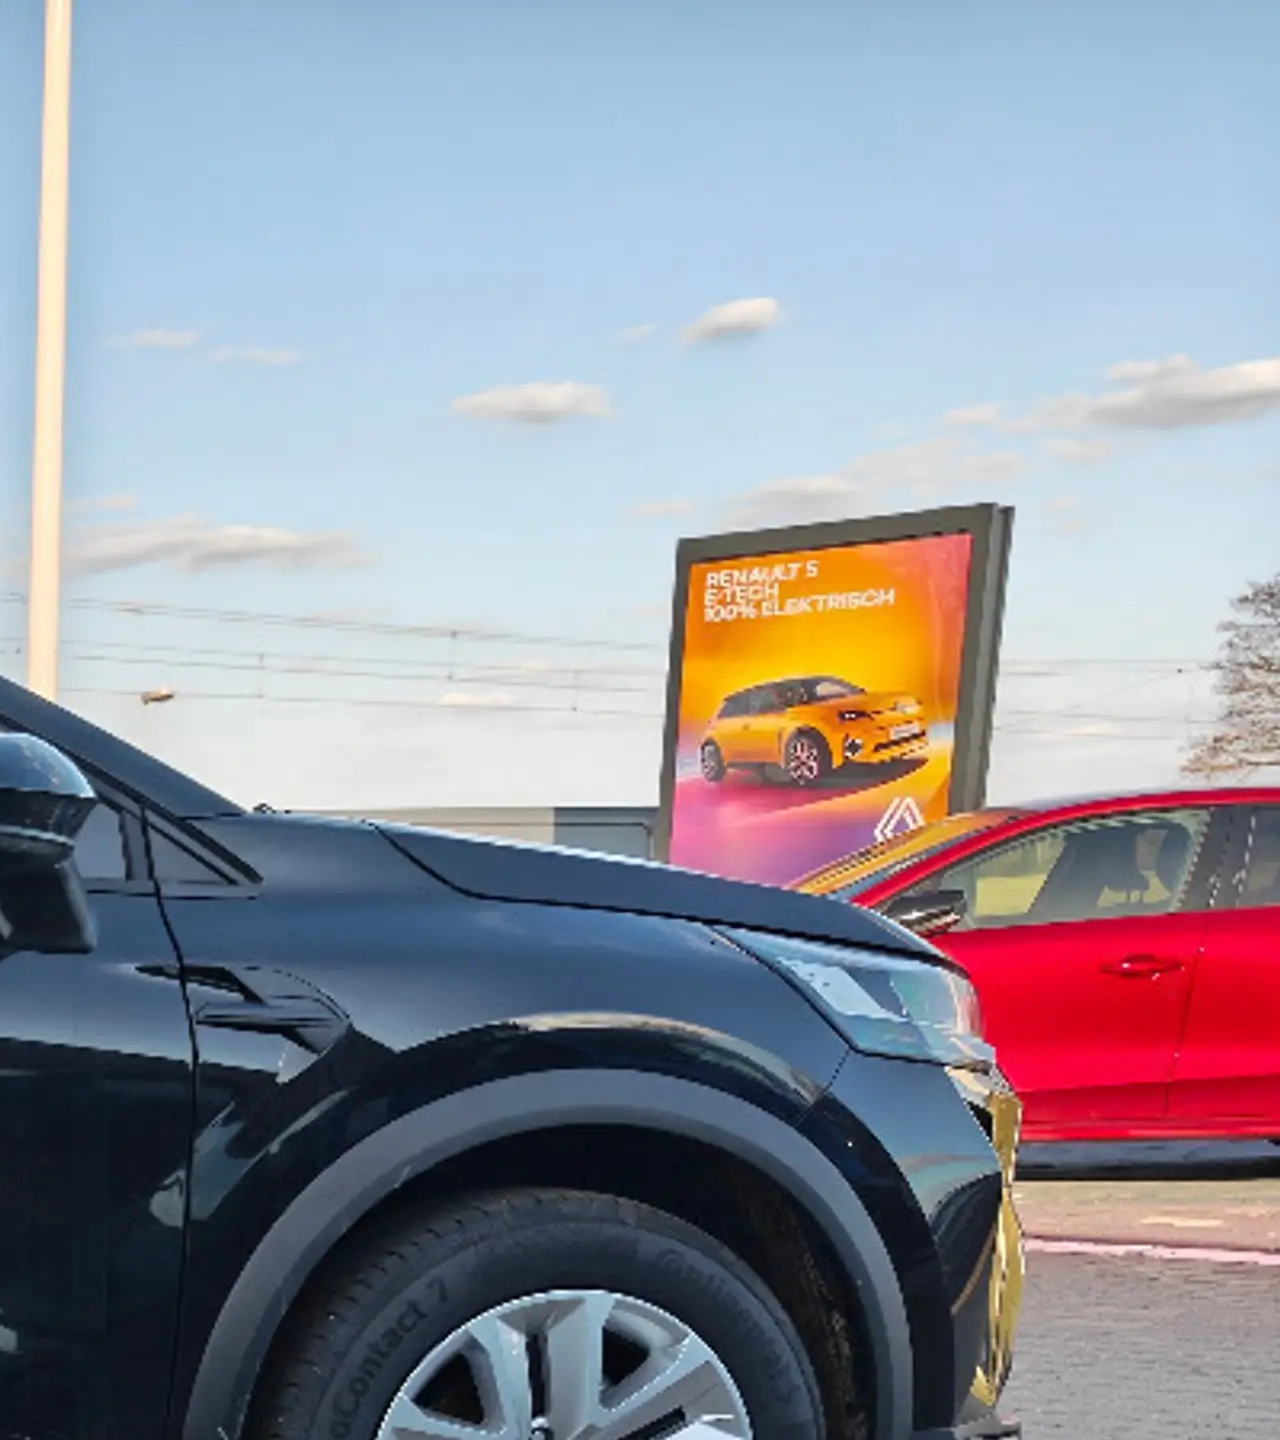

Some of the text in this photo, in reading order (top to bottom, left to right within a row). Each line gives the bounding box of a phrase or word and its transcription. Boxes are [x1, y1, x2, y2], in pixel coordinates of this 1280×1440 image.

[705, 560, 820, 588] RENAULT 5
[704, 587, 896, 623] 100% ELEKTRISCH
[425, 1277, 447, 1303] 7
